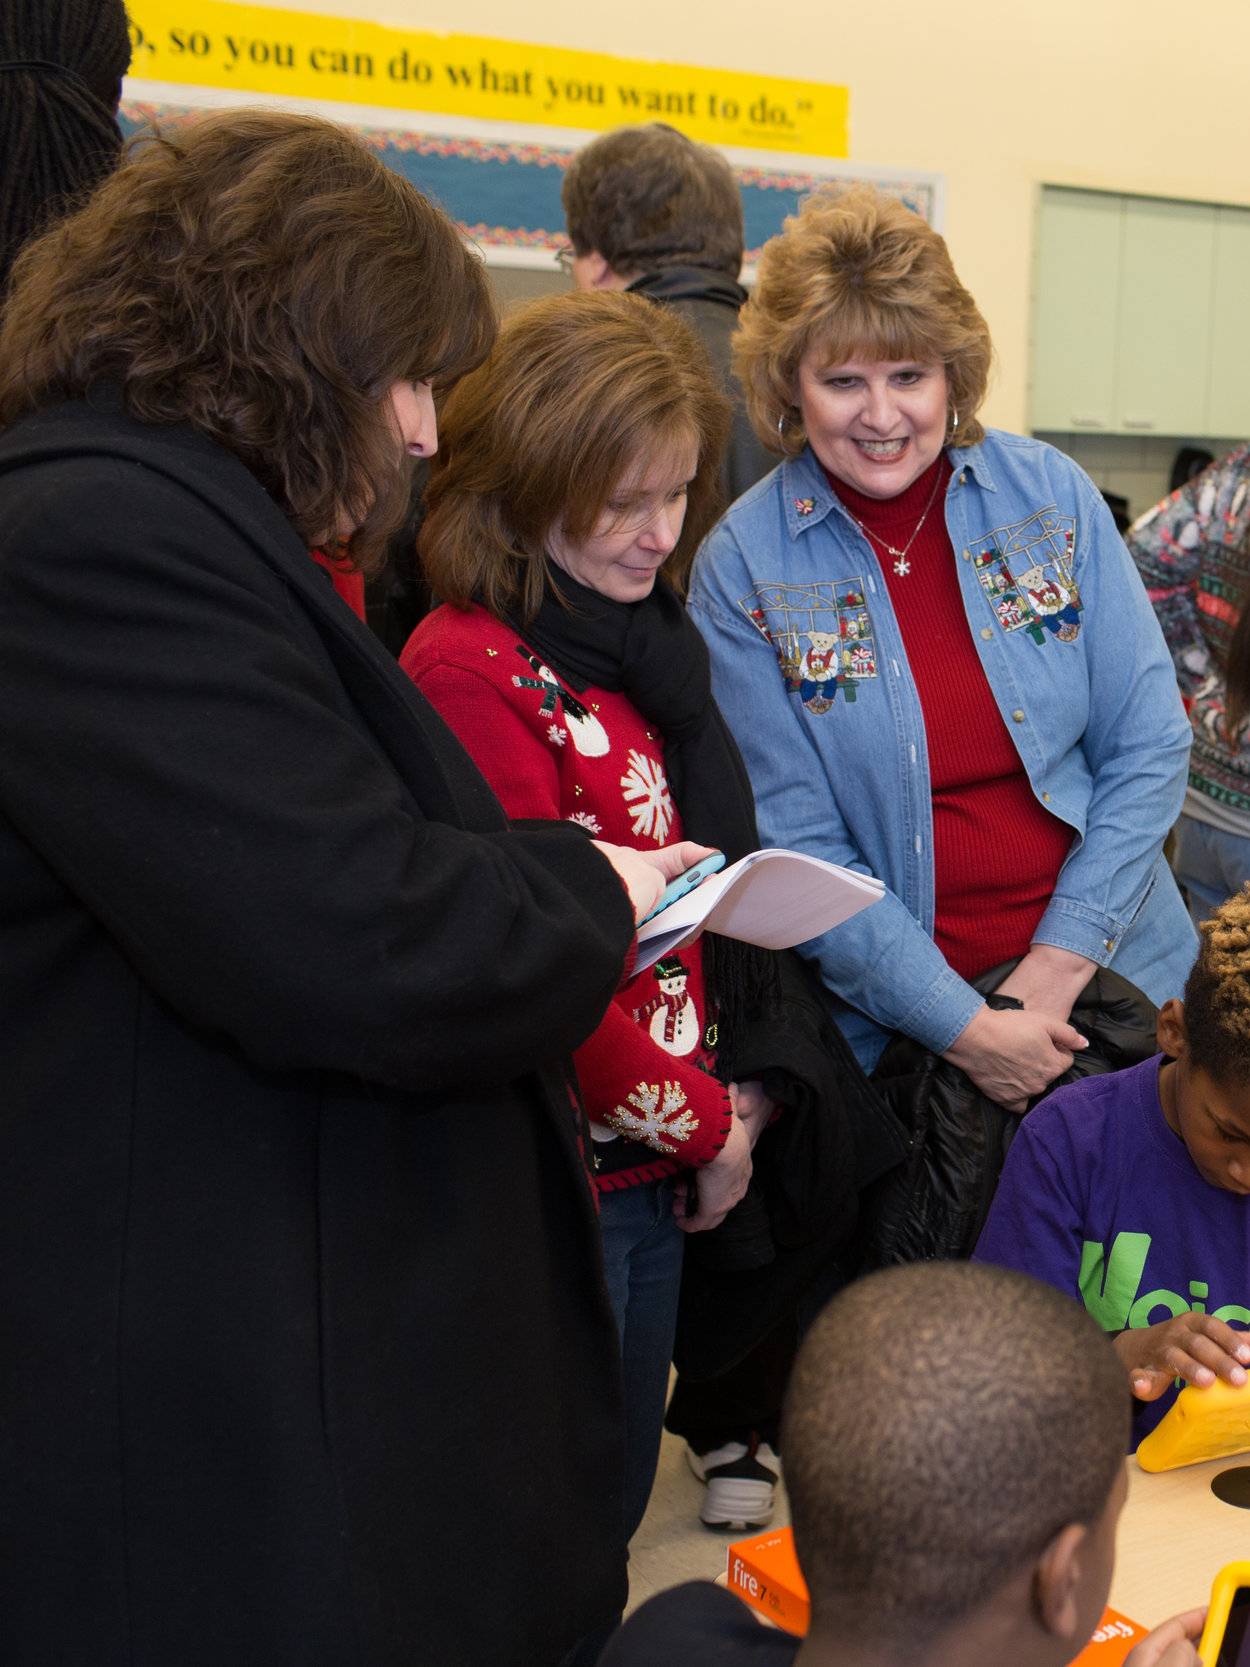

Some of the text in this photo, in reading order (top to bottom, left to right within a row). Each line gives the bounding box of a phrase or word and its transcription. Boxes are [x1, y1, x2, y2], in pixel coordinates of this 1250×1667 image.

[169, 26, 211, 57] so
[223, 33, 296, 71] you
[309, 45, 374, 77] can
[388, 47, 433, 85] do
[446, 57, 533, 96] what
[543, 74, 605, 111] you
[617, 84, 697, 117] want
[708, 90, 740, 121] to
[733, 1558, 768, 1601] fire 7
[1092, 1620, 1135, 1643] fire
